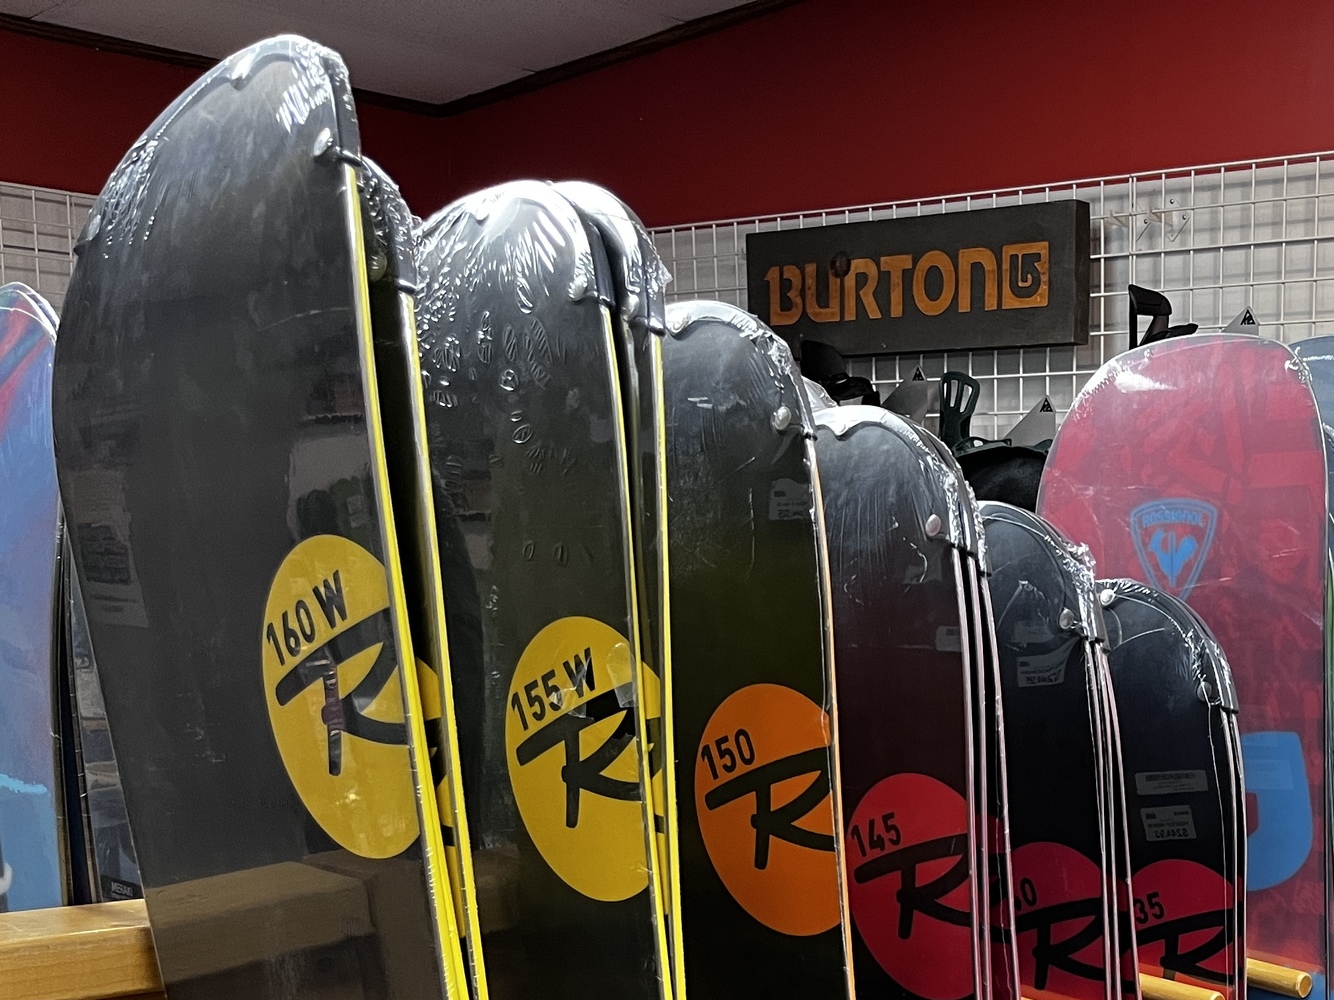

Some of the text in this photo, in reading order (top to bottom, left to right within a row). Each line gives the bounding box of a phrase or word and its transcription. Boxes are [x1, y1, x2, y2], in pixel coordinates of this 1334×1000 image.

[763, 247, 998, 327] BURTON
[265, 569, 348, 667] 160 W
[510, 646, 598, 732] 155 W
[700, 728, 756, 781] 150
[850, 811, 902, 859] 145
[1136, 890, 1166, 924] 35
